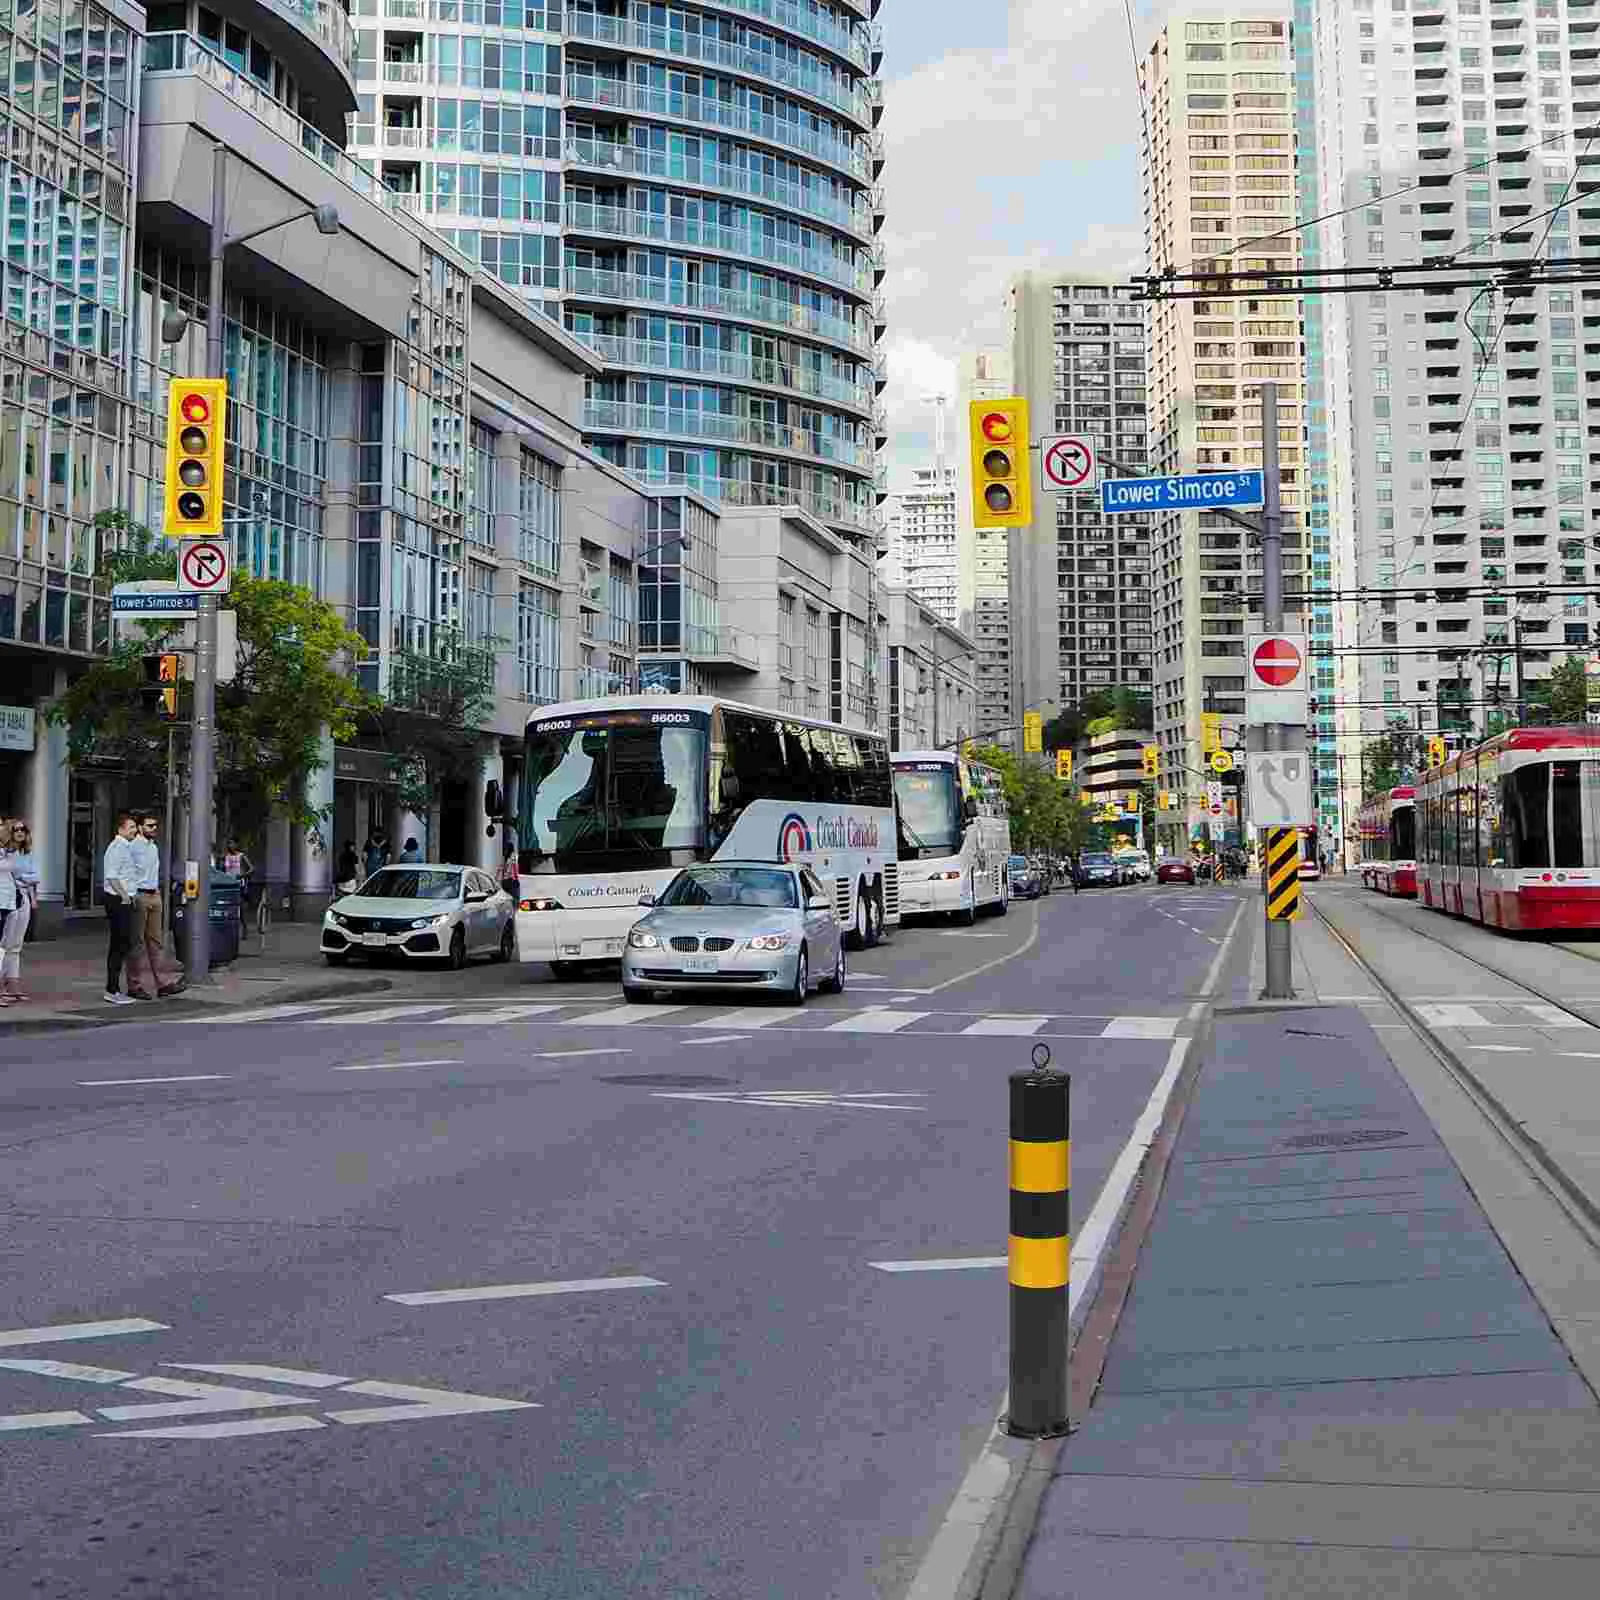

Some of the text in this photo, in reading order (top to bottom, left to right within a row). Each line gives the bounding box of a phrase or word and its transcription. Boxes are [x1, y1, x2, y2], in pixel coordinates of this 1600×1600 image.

[1107, 483, 1162, 505] Lower
[1166, 478, 1236, 501] Simcoe
[115, 596, 144, 609] Lower
[145, 596, 184, 609] Simcoe
[816, 815, 878, 849] Coach Canada
[567, 883, 656, 897] Coach Canada
